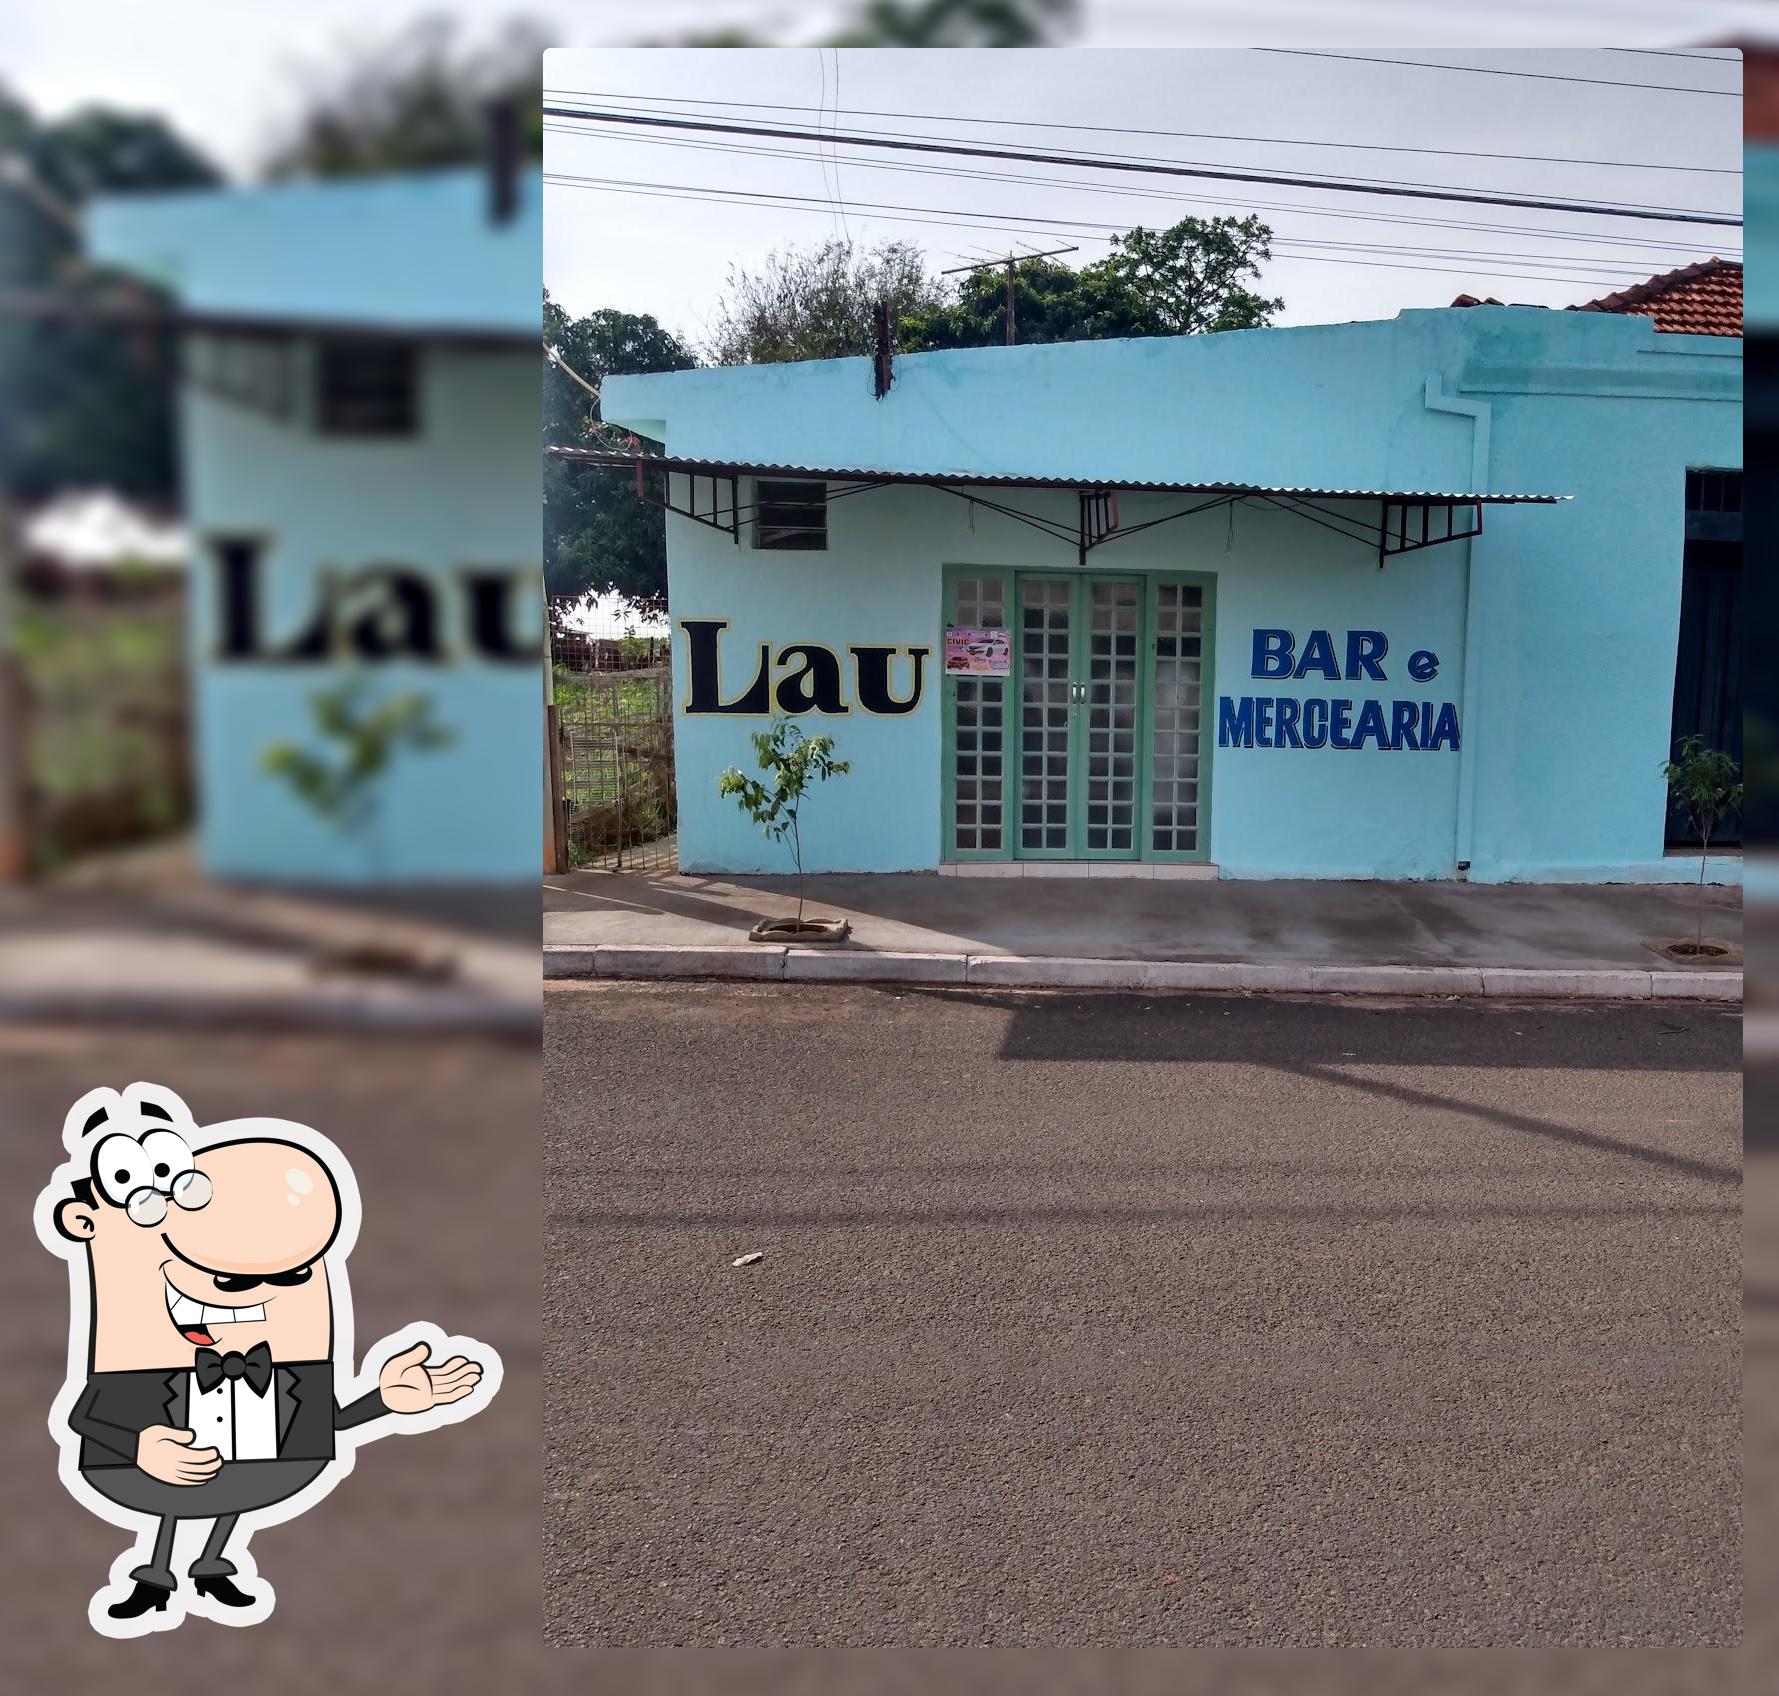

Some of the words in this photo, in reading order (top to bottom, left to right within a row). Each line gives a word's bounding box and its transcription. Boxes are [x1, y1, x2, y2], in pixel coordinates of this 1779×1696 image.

[679, 618, 931, 715] Lau
[1251, 629, 1388, 681] BAR
[1407, 650, 1439, 682] e
[1218, 696, 1461, 751] MERCEARIA
